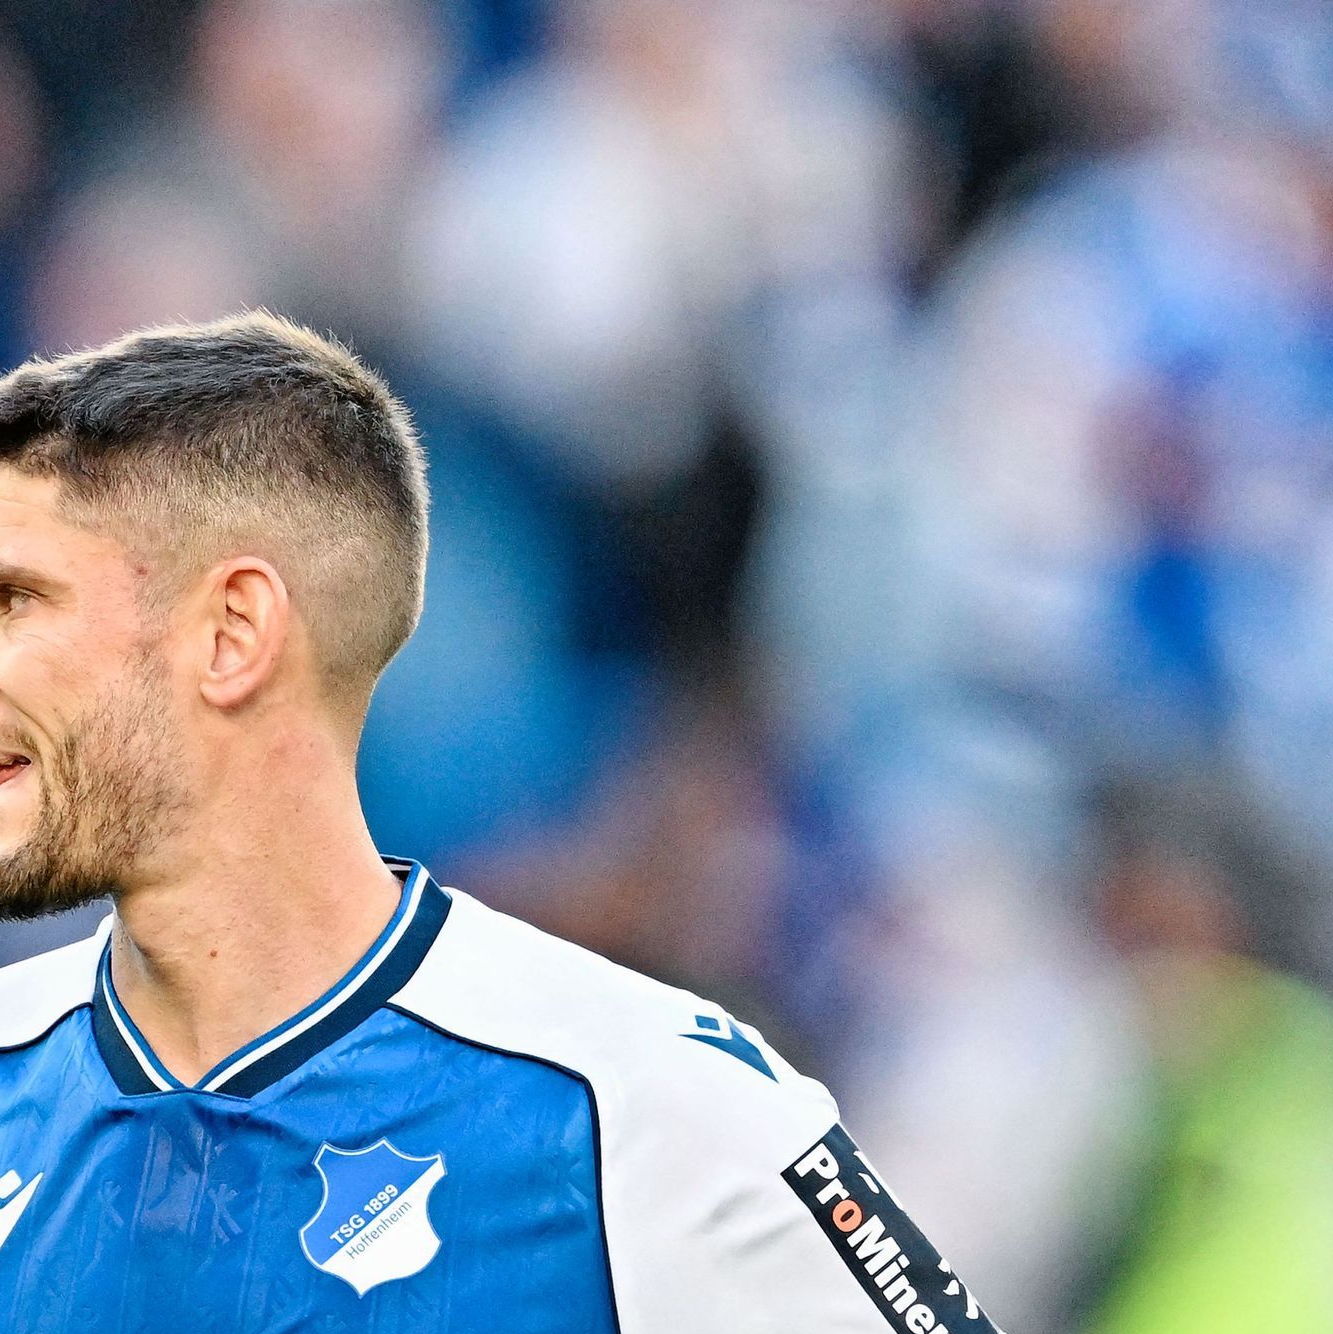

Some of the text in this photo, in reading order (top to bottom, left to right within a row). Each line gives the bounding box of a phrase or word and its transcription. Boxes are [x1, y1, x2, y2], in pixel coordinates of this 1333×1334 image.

[329, 1183, 399, 1245] TSG 1899
[345, 1200, 413, 1260] Hoffenheim
